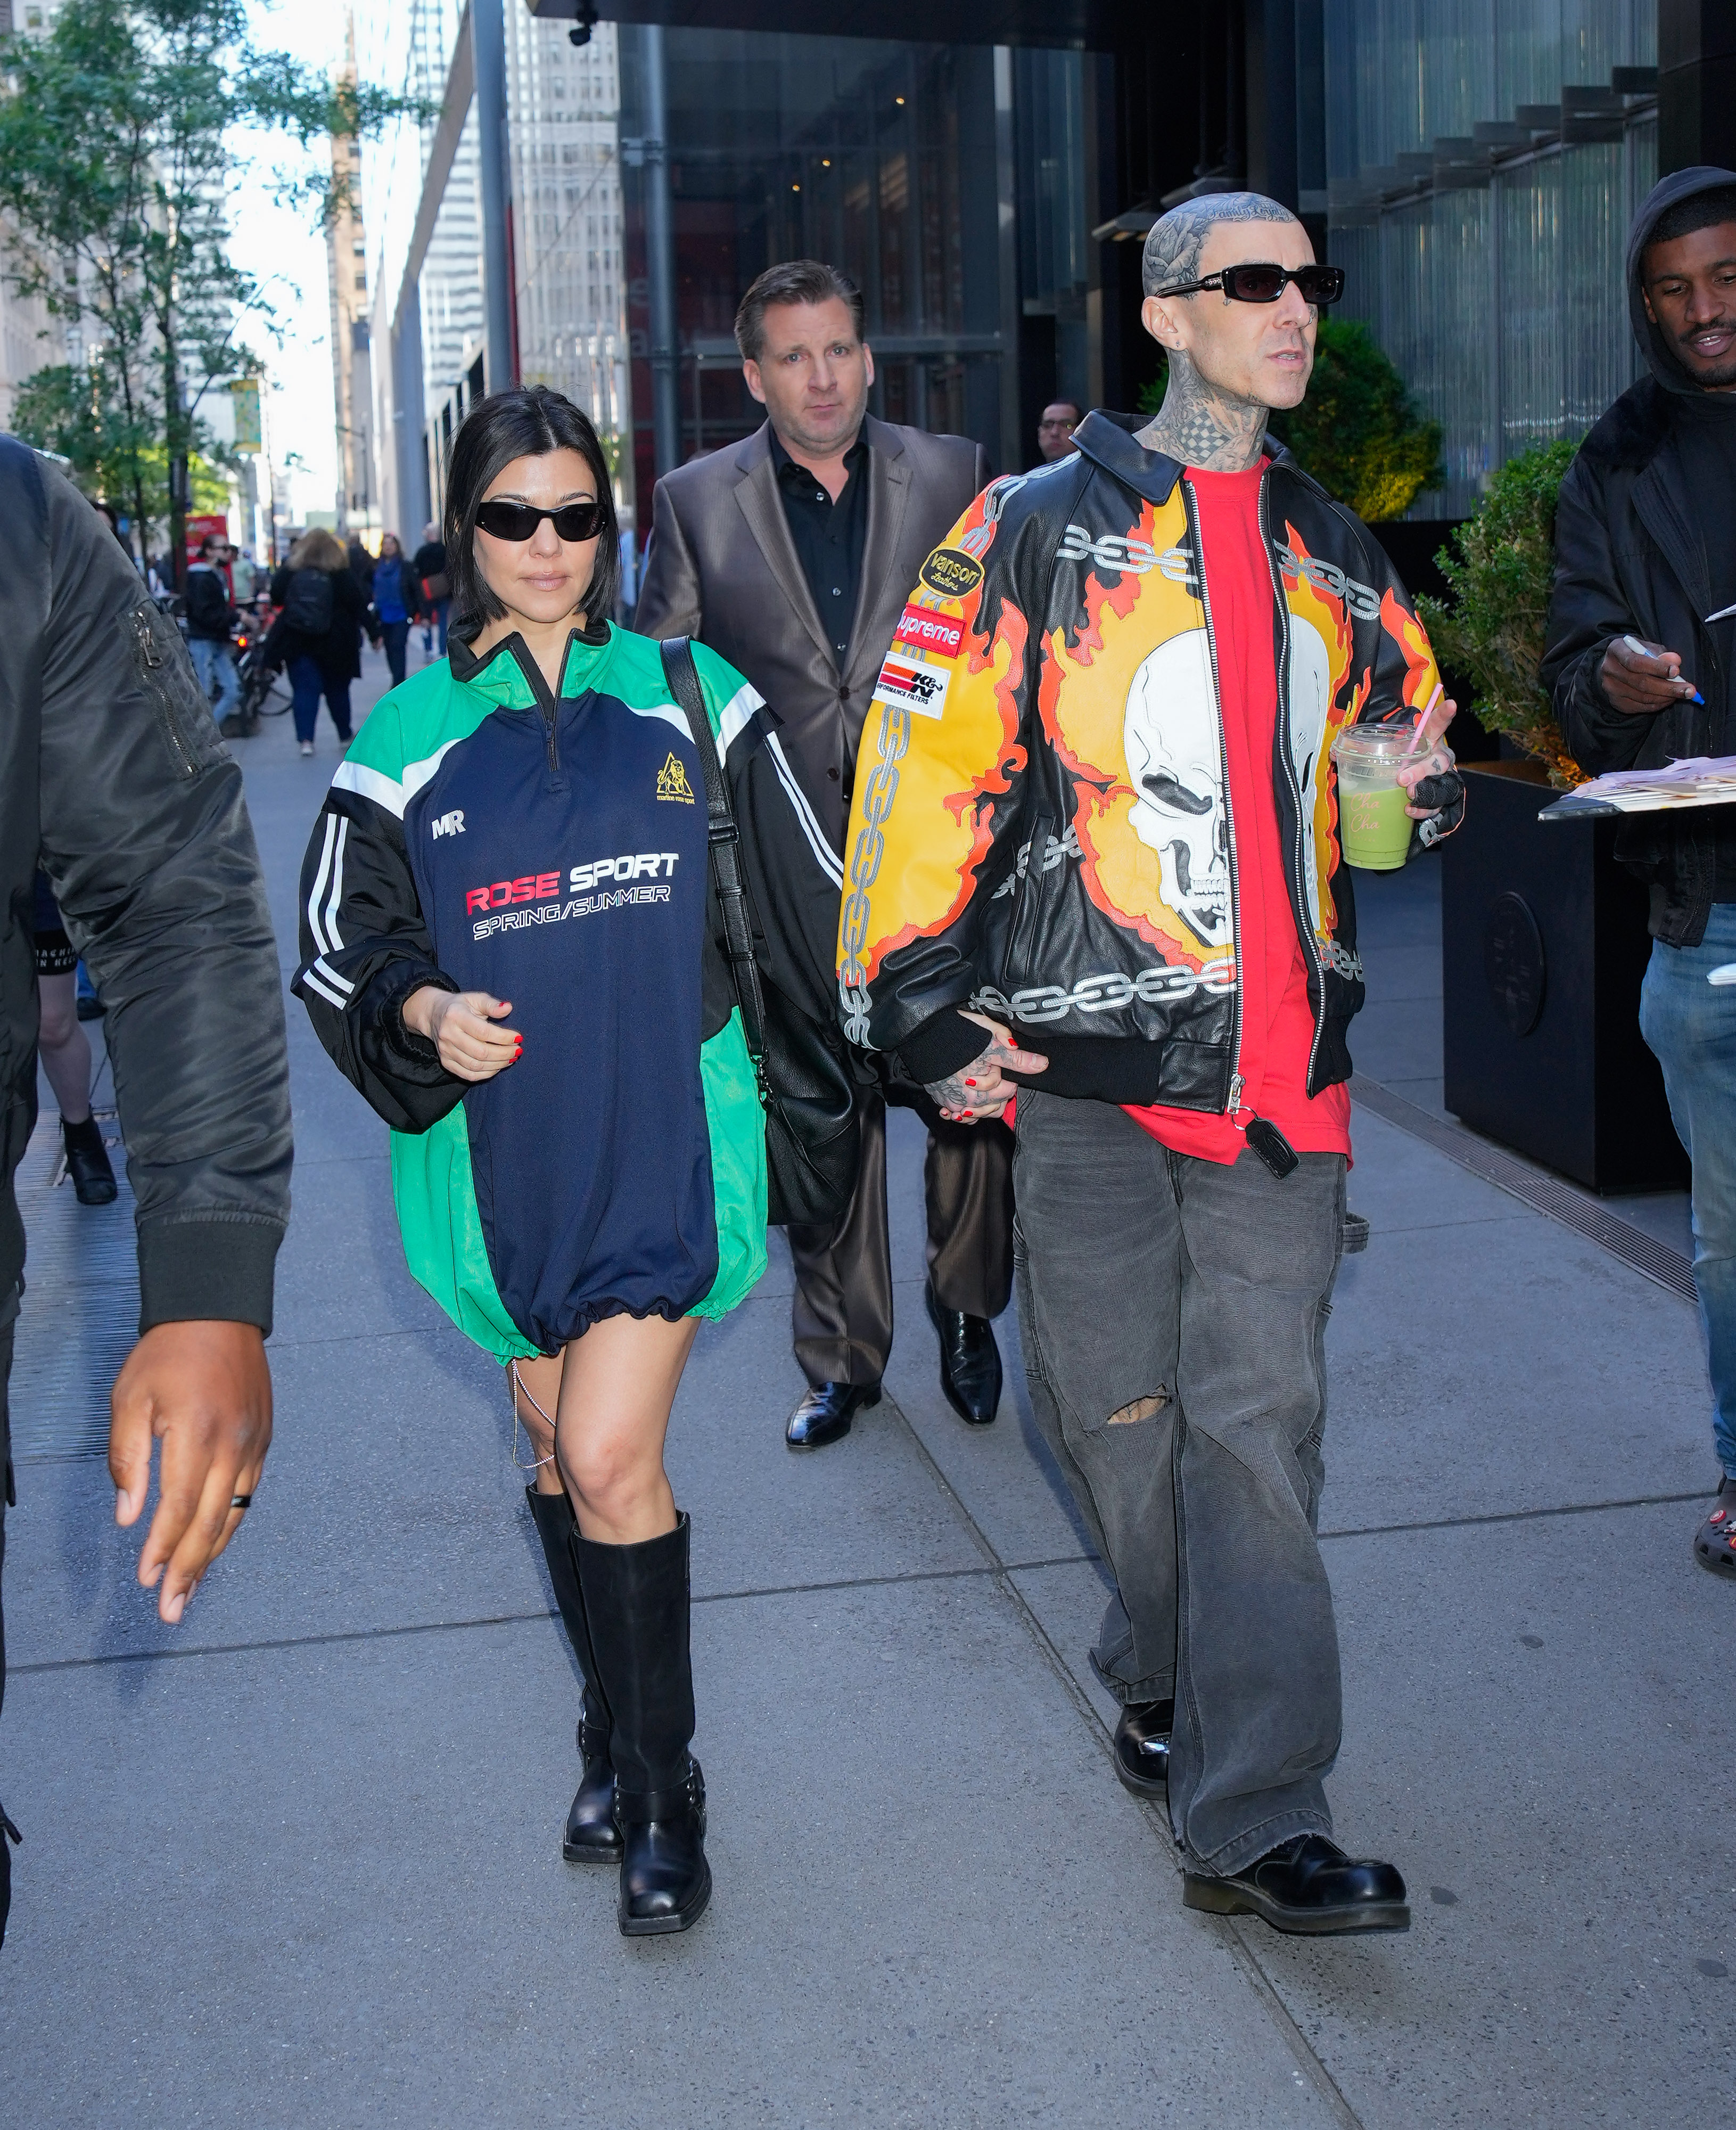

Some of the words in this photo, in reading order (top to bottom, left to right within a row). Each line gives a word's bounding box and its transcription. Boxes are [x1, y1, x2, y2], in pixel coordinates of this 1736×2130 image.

[931, 553, 978, 585] vanson
[931, 572, 958, 591] Leathers
[907, 693, 929, 704] FILTERS
[1351, 792, 1380, 812] Cha
[431, 809, 466, 840] MR
[1351, 814, 1380, 832] Cha
[465, 871, 561, 915] ROSE
[570, 853, 679, 892] SPORT
[473, 884, 671, 940] SPRING/SUMMER
